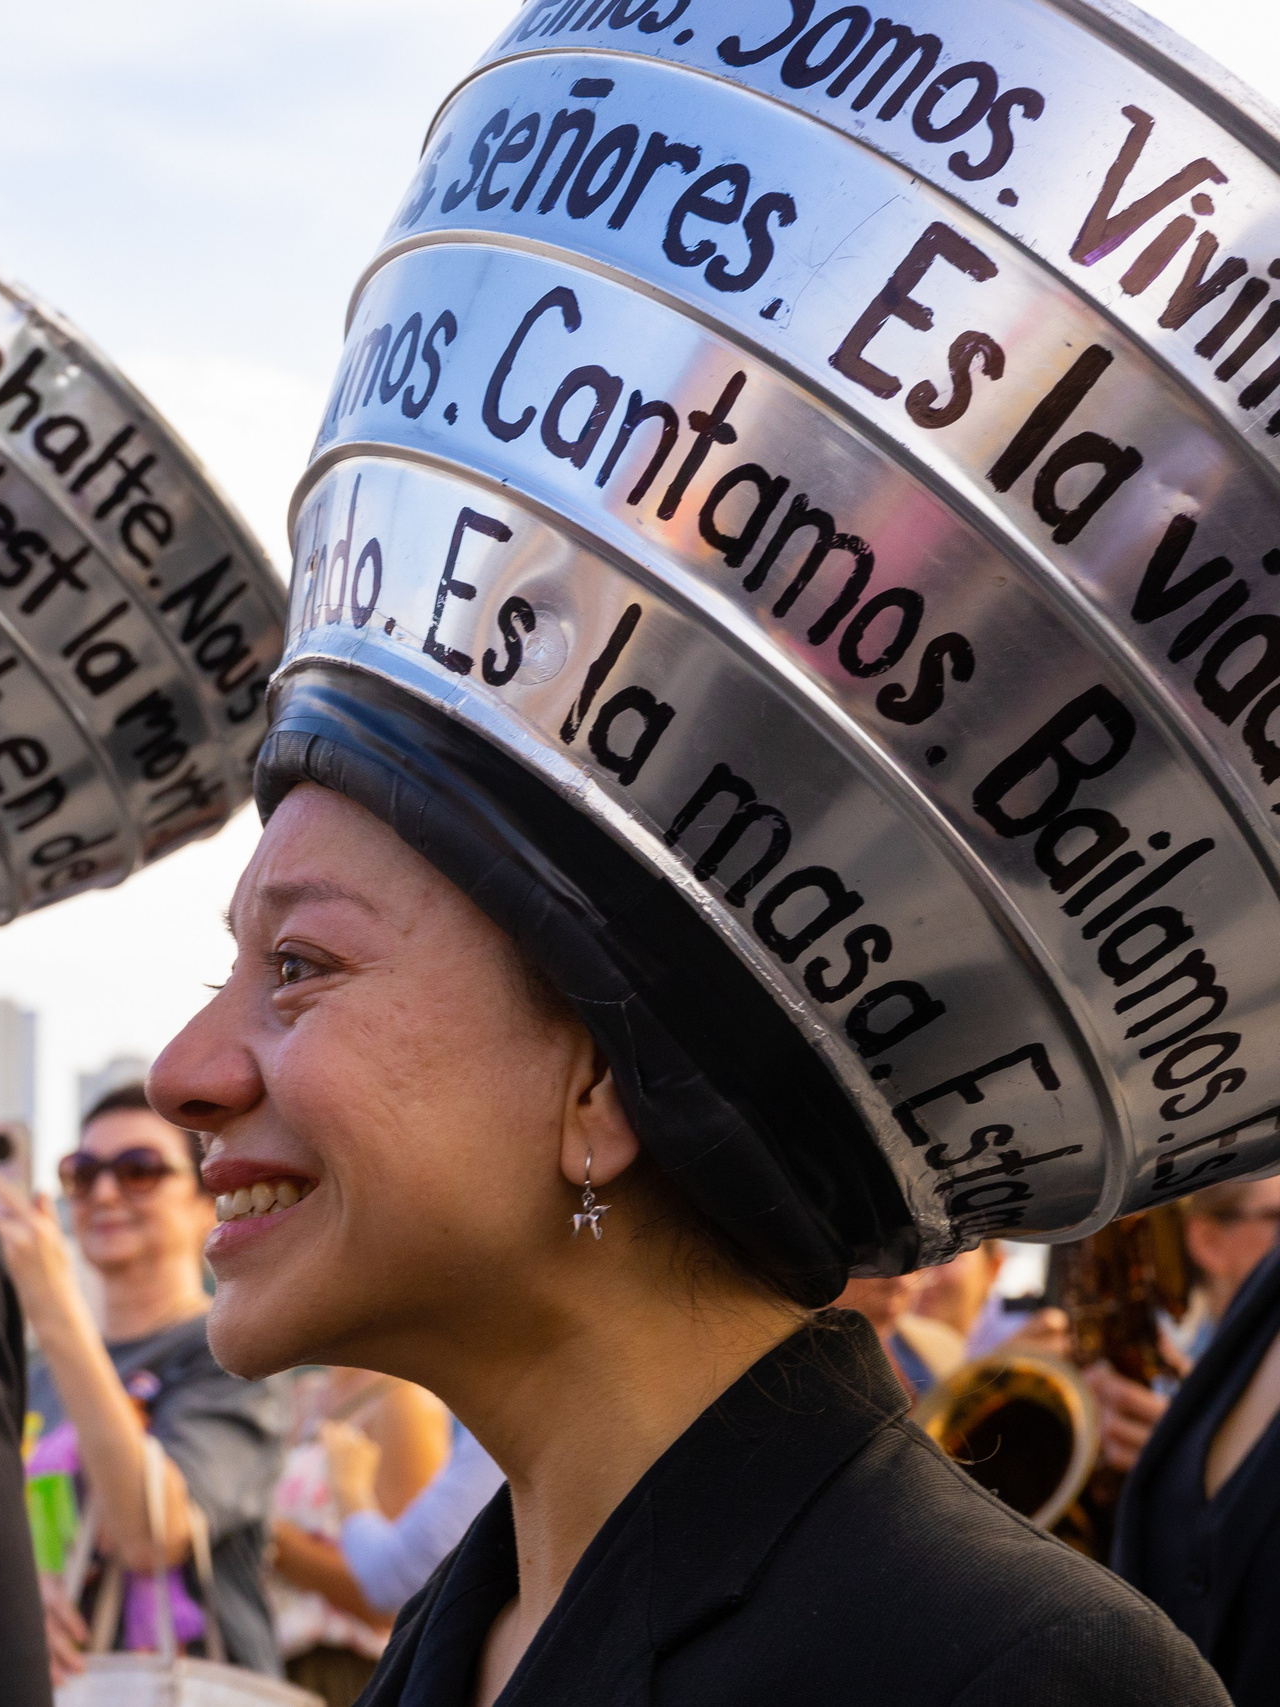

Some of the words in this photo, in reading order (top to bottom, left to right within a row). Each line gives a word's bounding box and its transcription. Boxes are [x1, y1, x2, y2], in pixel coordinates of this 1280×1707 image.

[440, 77, 798, 320] señores.
[828, 221, 1006, 429] Es
[985, 343, 1143, 545] la
[61, 600, 139, 696] la
[159, 555, 268, 724] Nous
[423, 506, 536, 687] Es
[559, 603, 676, 786] la
[663, 763, 947, 1081] masa.
[892, 1042, 1084, 1237] Estam
[481, 286, 975, 767] Cantamos.
[972, 684, 1247, 1143] Bailamos.
